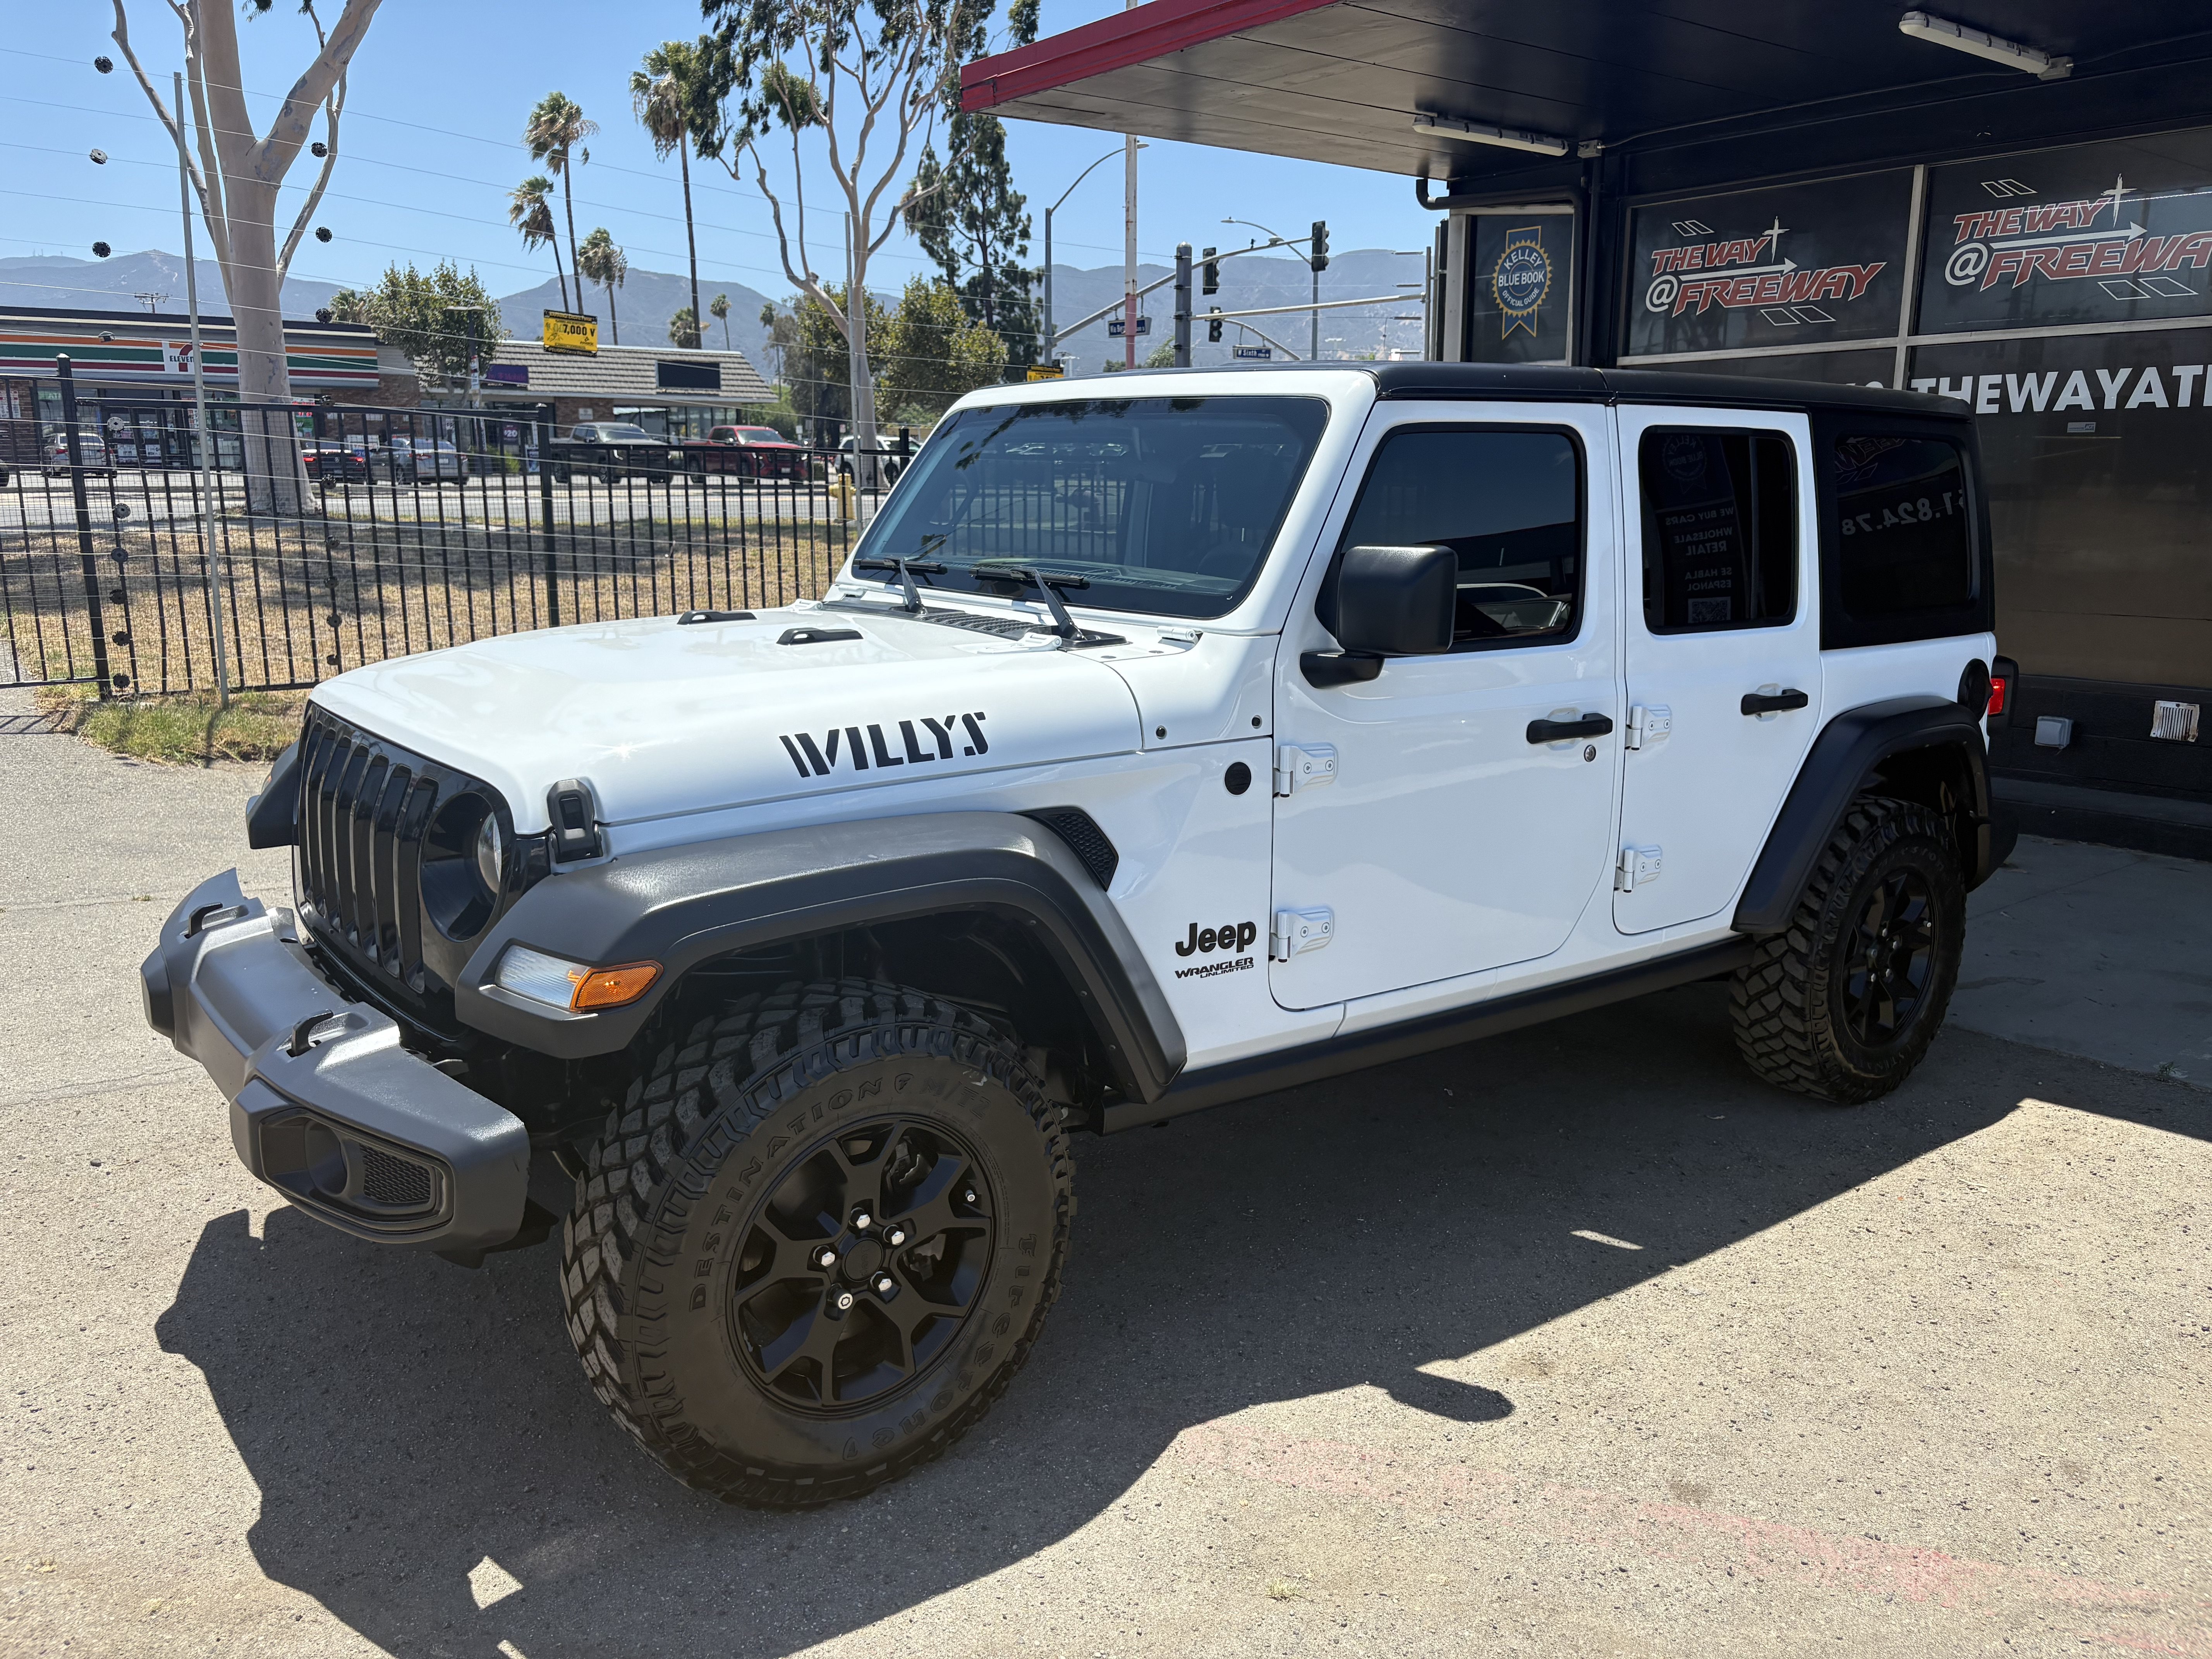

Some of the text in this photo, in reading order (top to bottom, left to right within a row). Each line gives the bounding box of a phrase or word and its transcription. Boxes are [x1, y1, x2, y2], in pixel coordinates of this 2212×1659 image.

[1503, 249, 1542, 270] KELLEY
[1498, 270, 1545, 287] BLUE BOOK
[1502, 287, 1540, 306] OFFICIAL GUIDE
[563, 324, 596, 337] 7,000 V
[1175, 921, 1257, 957] Jeep
[1174, 957, 1254, 979] WRANGLER
[1200, 964, 1254, 979] UNLIMITED
[689, 1076, 884, 1311] DESTINATION
[871, 1233, 1037, 1449] Firestone
